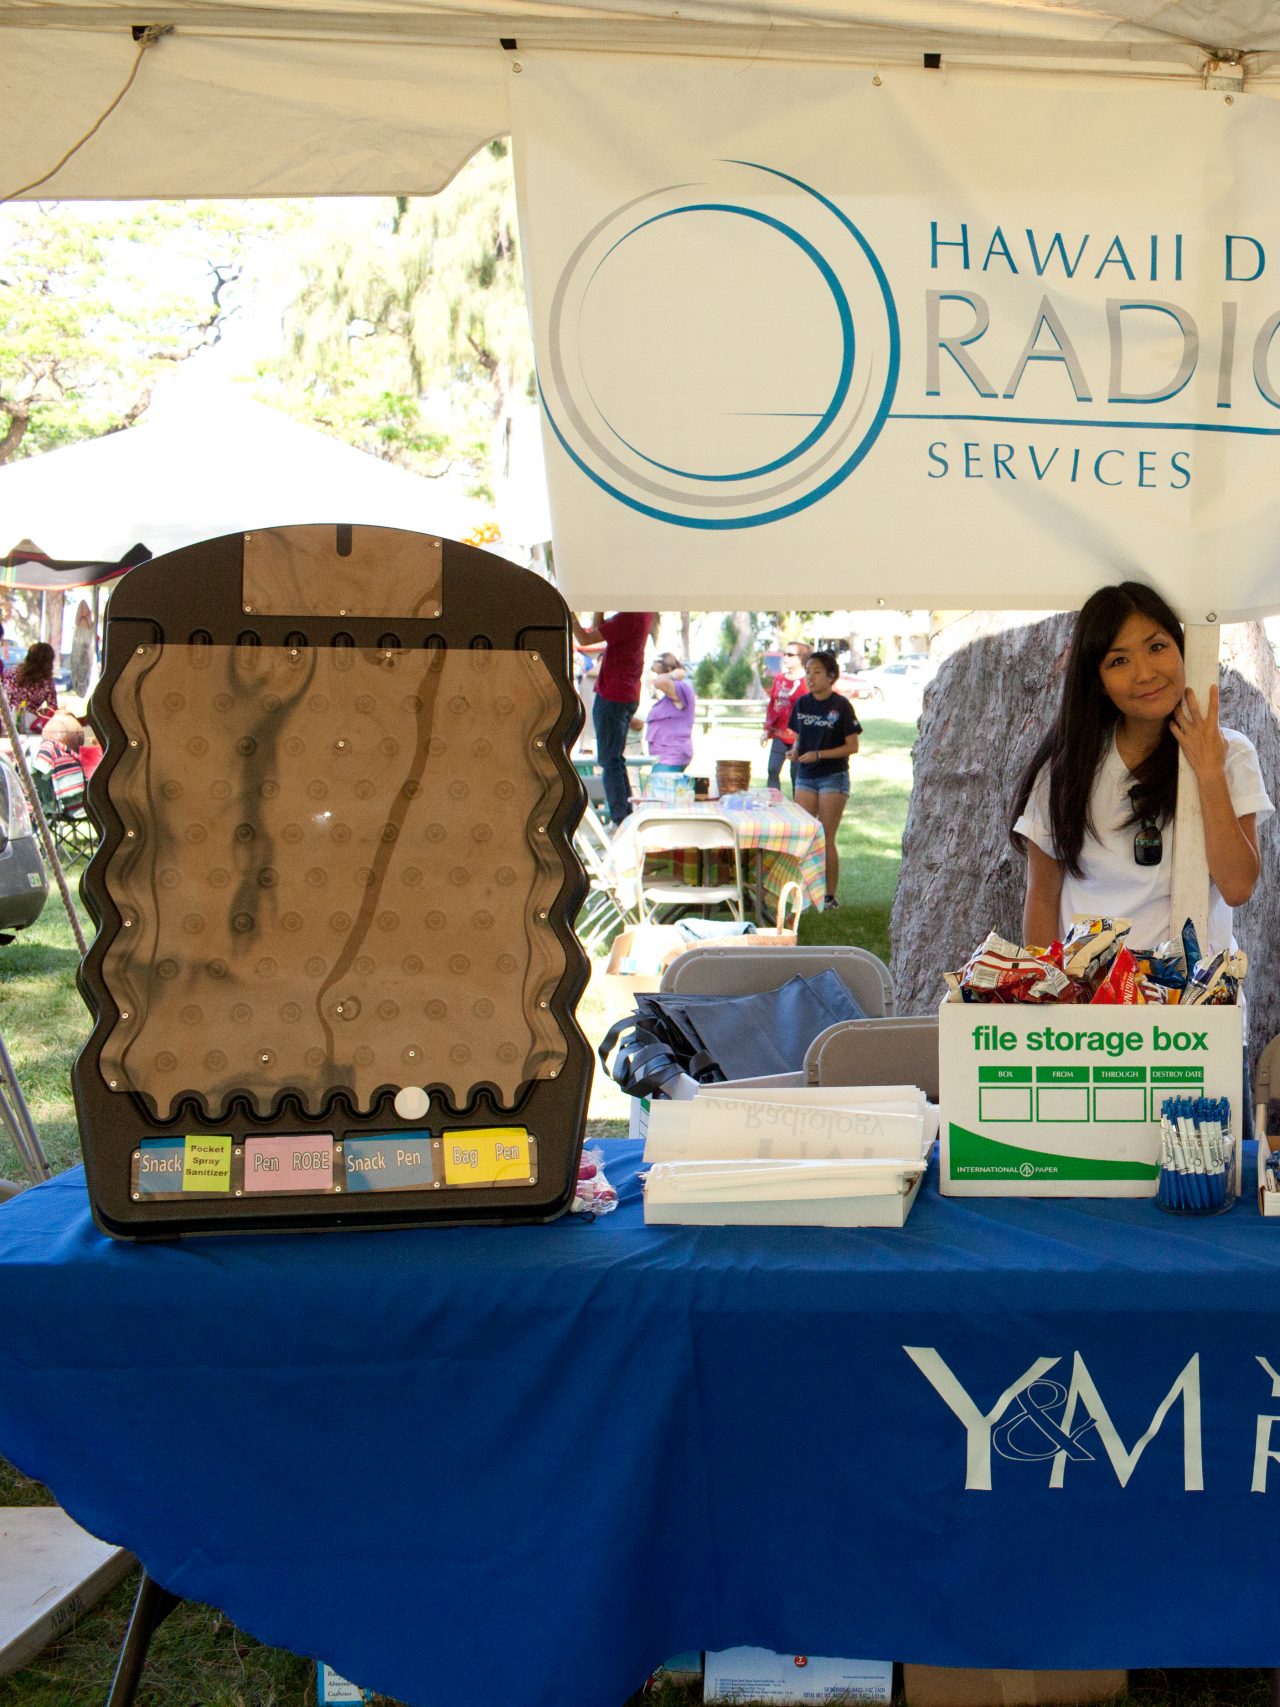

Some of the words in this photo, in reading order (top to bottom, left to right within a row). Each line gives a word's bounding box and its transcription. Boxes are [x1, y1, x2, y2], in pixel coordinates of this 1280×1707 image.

[930, 221, 1183, 281] HAWAII
[927, 441, 1192, 489] SERVICES
[1123, 971, 1136, 1004] ORIGINA
[971, 1025, 1018, 1051] file
[1026, 1026, 1144, 1057] storage
[1152, 1025, 1209, 1051] box
[998, 1070, 1014, 1078] BOX
[1052, 1070, 1074, 1078] FROM
[1101, 1070, 1139, 1078] THROUGH
[1152, 1070, 1183, 1078] DESTROY
[1185, 1070, 1203, 1078] DATE
[190, 1145, 225, 1154] Pocket
[452, 1146, 479, 1168] Bag
[495, 1143, 520, 1162] Pen
[142, 1153, 182, 1173] Snack
[192, 1156, 220, 1166] Spray
[253, 1153, 280, 1172] Pen
[292, 1151, 330, 1171] ROBE
[347, 1152, 387, 1173] Snack
[396, 1149, 422, 1168] Pen
[957, 1166, 1018, 1174] INTERNATIONAL
[1034, 1166, 1059, 1174] PAPER
[185, 1167, 229, 1178] Sanitizer
[902, 1345, 1205, 1492] Y&M
